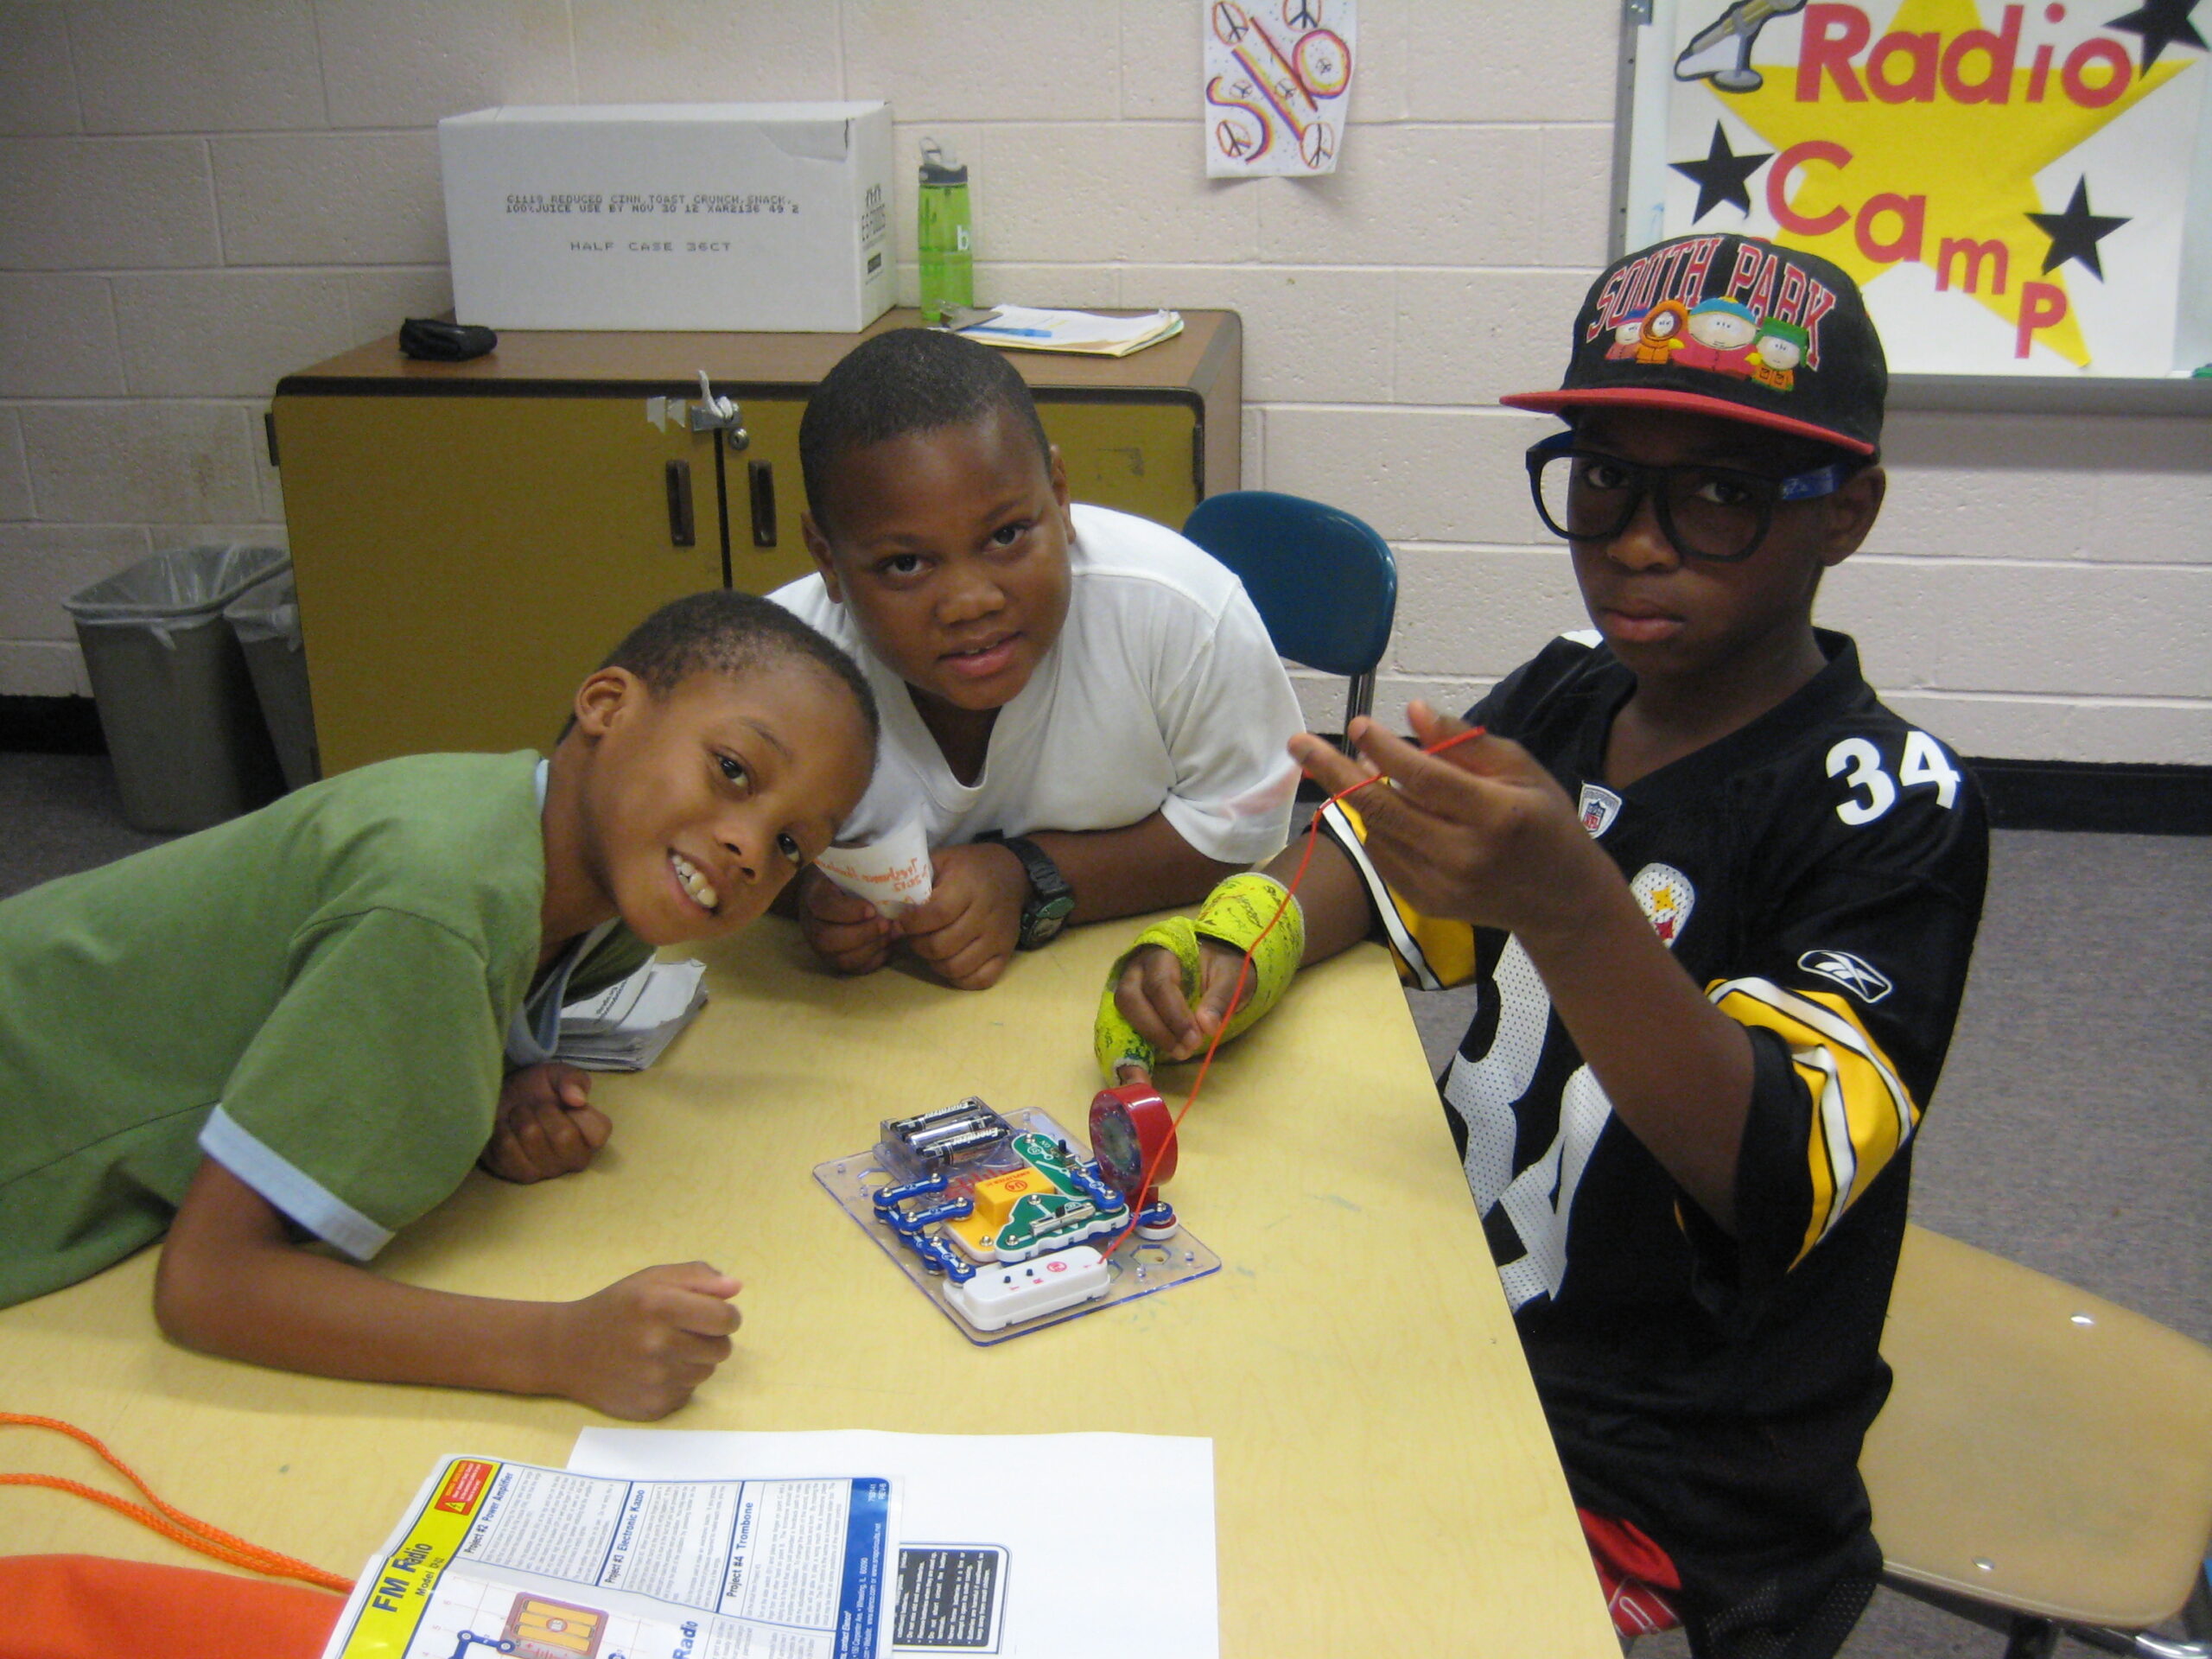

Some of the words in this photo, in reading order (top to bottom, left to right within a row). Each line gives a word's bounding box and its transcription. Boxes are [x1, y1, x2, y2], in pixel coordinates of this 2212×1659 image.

[1795, 3, 2133, 109] Radio
[551, 194, 602, 204] REDUCED
[571, 242, 613, 251] HALF
[629, 242, 672, 251] CASE
[1586, 237, 1726, 343] SOUTH
[1727, 244, 1836, 372] PARK
[1825, 730, 1961, 826] 34
[493, 1471, 513, 1502] Amplifier
[481, 1502, 499, 1522] Power
[735, 1502, 753, 1550] Trombone
[477, 1524, 488, 1533] #2
[605, 1564, 622, 1583] Project
[617, 1514, 638, 1552] Electronic
[629, 1490, 645, 1512] Kazoo
[463, 1533, 484, 1554] Project
[732, 1555, 744, 1567] #4
[372, 1577, 410, 1612] FM
[391, 1543, 433, 1573] Radio
[415, 1571, 435, 1596] Model
[726, 1570, 742, 1598] Project
